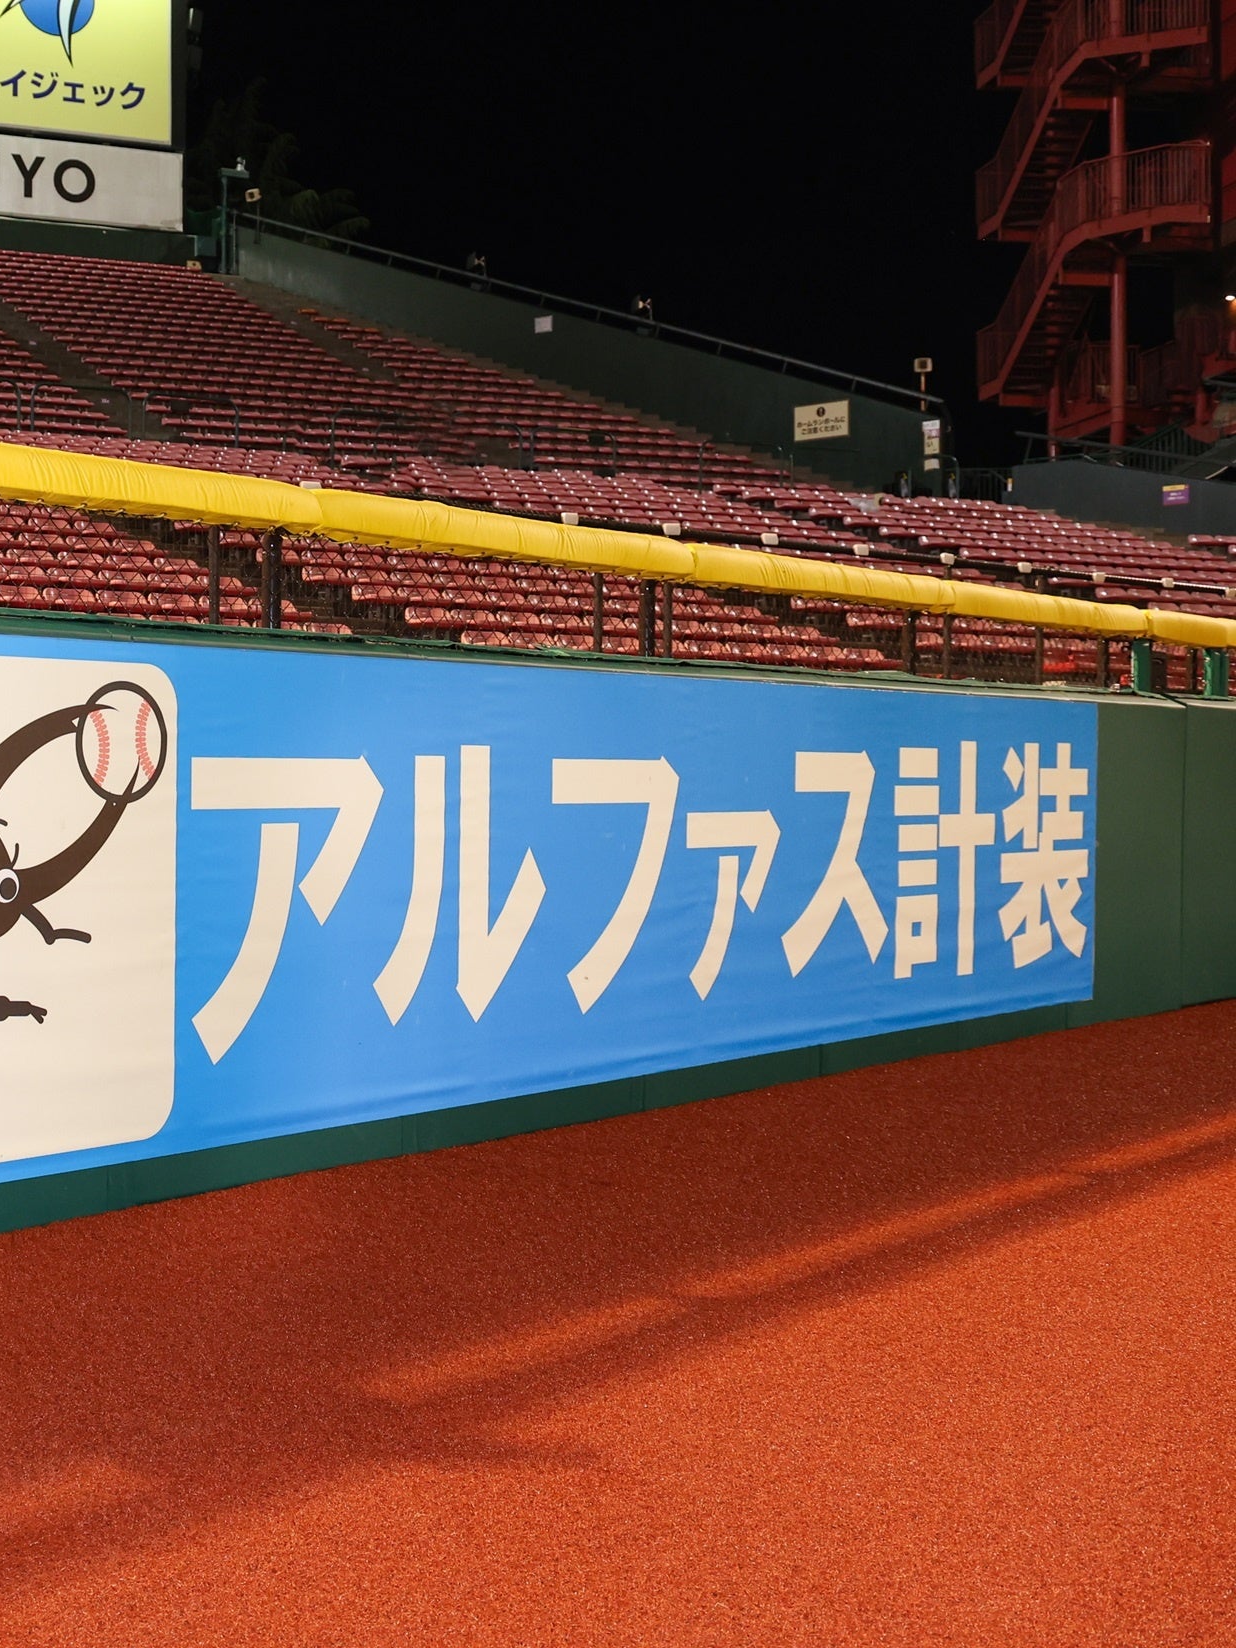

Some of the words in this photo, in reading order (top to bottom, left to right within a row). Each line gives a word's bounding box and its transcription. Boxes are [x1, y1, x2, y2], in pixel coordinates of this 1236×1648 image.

[191, 740, 1091, 1066] アルファス計装
